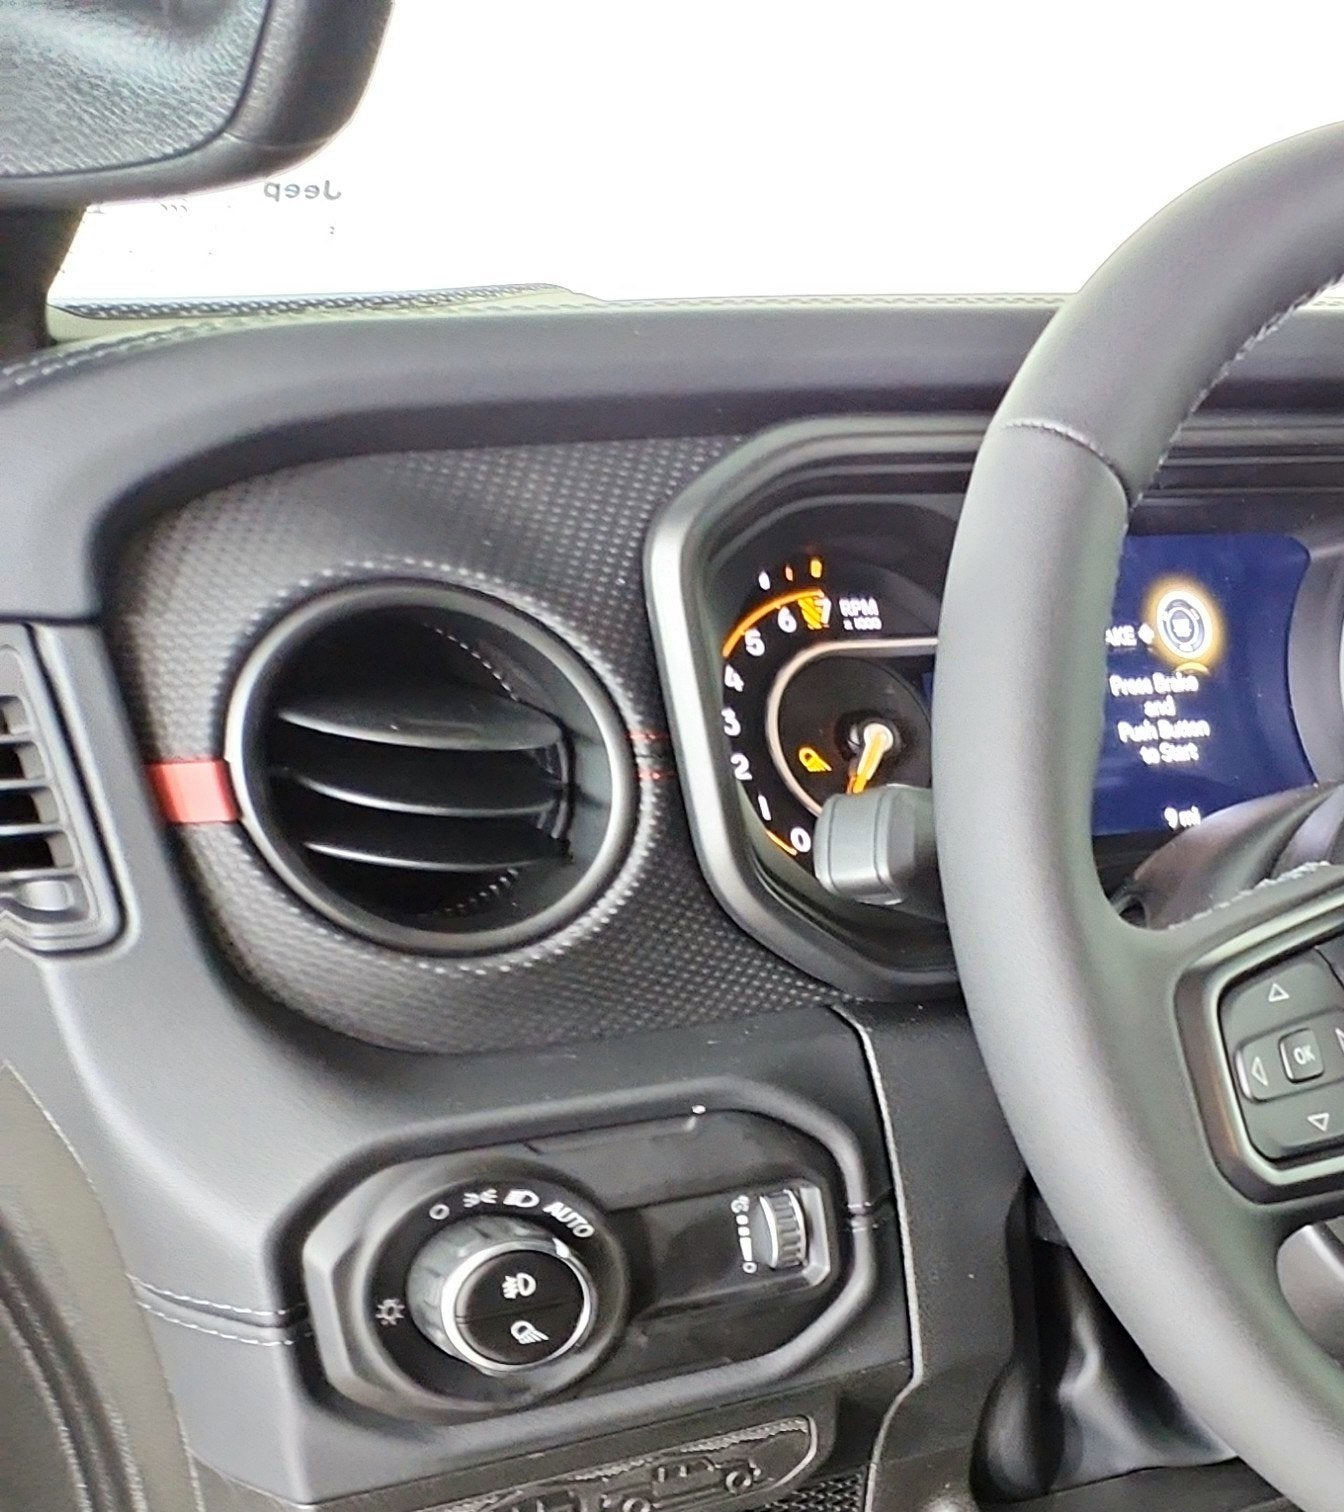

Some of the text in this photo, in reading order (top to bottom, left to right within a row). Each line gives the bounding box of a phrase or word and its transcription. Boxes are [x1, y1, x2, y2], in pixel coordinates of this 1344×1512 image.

[777, 607, 797, 633] 6
[839, 597, 879, 618] RPM
[744, 629, 765, 656] 5
[724, 664, 744, 692] 4
[1109, 671, 1199, 697] Press Brake
[1144, 694, 1176, 718] and
[721, 706, 741, 736] 3
[1117, 718, 1211, 743] Push Button
[730, 752, 753, 780] 2
[1139, 741, 1200, 765] to Start
[758, 793, 771, 821] 1
[1164, 806, 1178, 829] 9
[790, 826, 812, 853] 0
[1293, 1044, 1316, 1065] OK
[543, 1201, 596, 1238] AUTO
